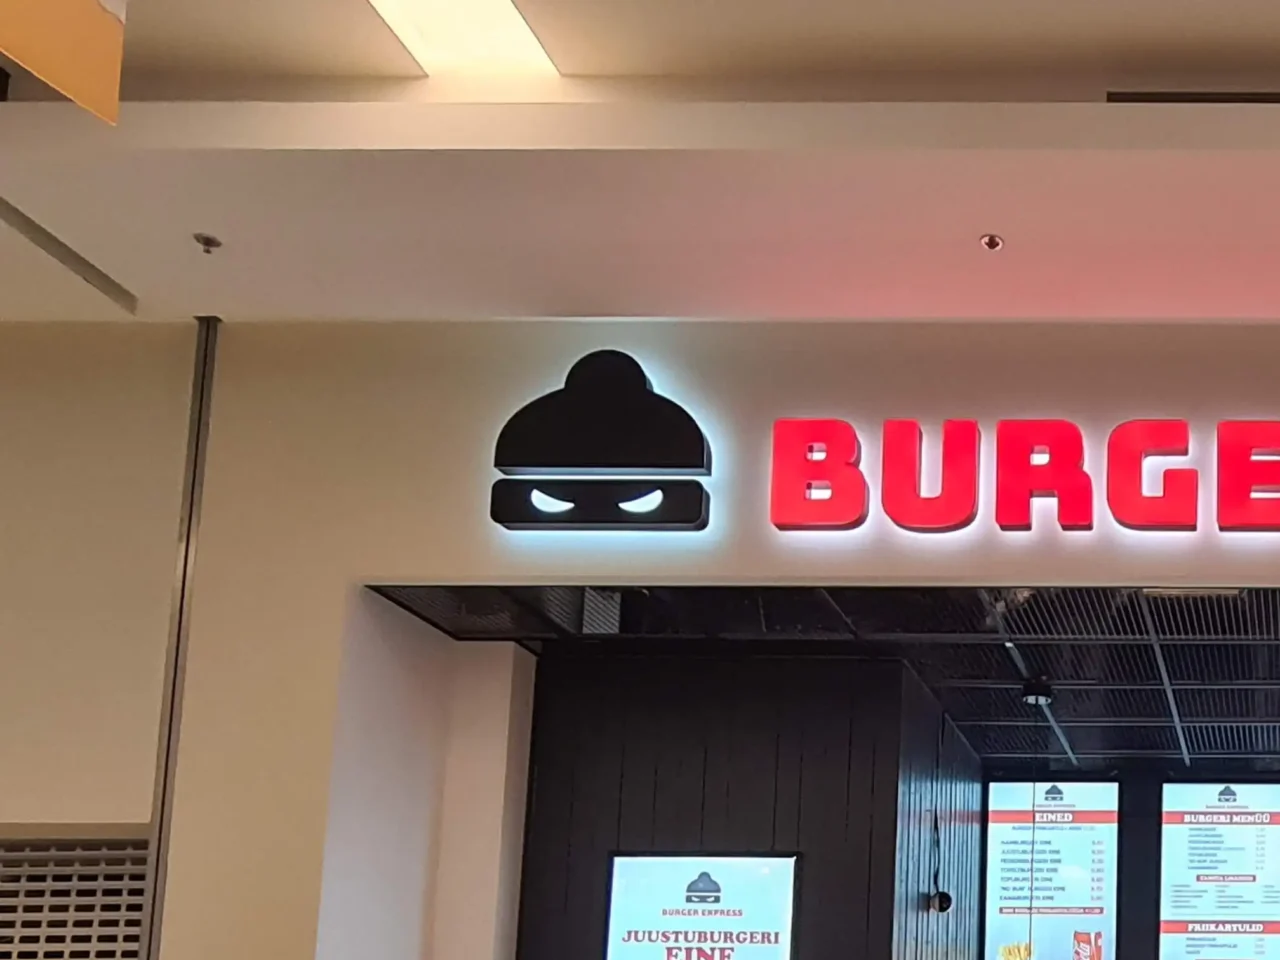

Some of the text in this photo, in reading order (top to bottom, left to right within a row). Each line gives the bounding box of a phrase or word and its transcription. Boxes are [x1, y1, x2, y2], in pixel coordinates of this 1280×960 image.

[1183, 814, 1231, 823] BURGERI
[661, 909, 743, 917] BURGER EXPRESS
[1187, 923, 1264, 932] FRIIKARTULID
[622, 930, 780, 944] JUUSTUBURGERI
